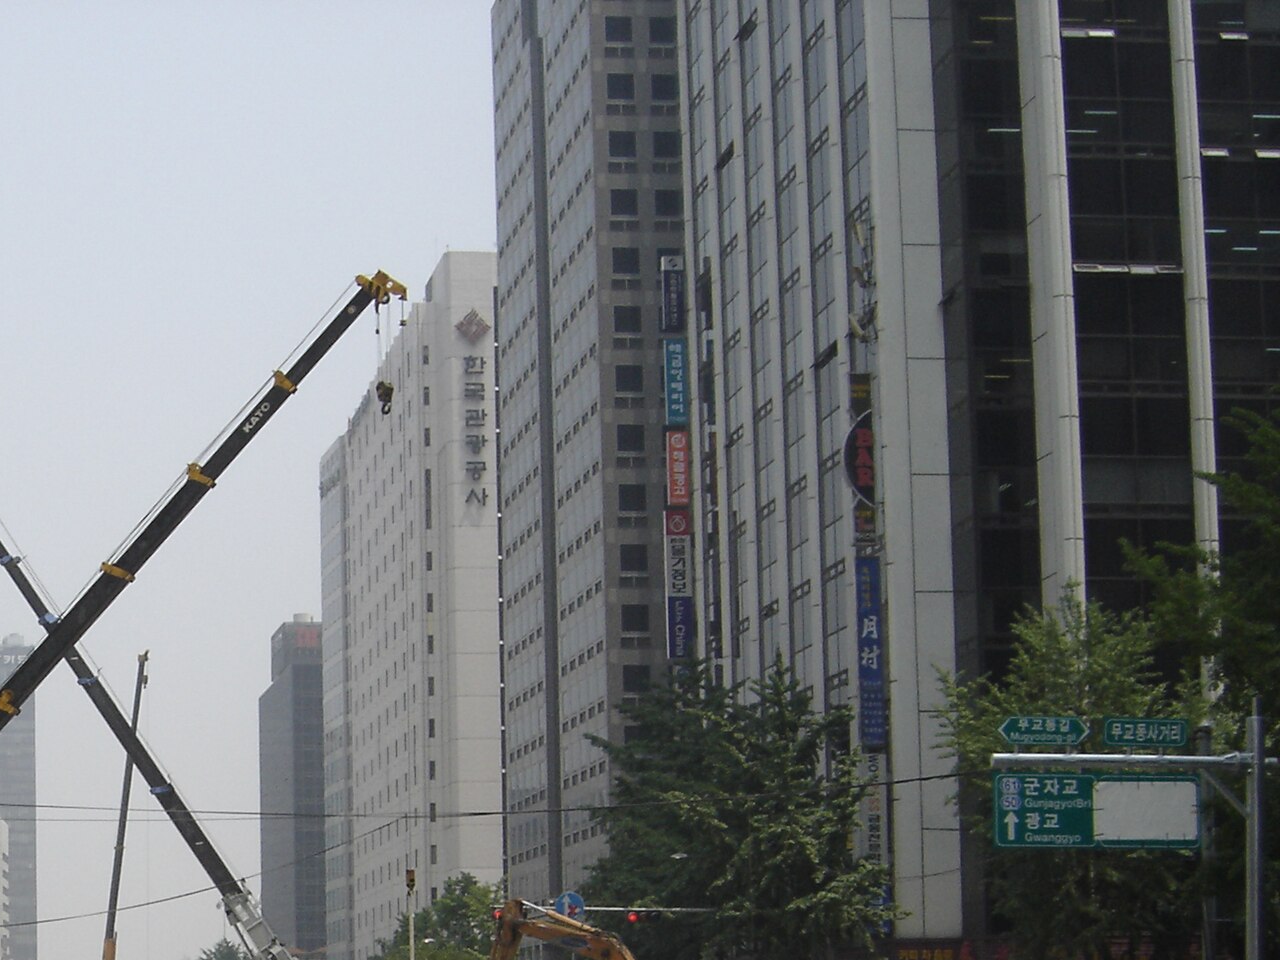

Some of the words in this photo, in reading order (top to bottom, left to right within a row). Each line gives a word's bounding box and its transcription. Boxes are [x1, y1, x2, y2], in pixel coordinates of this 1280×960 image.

[242, 401, 271, 433] KATO
[463, 355, 489, 507] 한국관광공사
[855, 428, 874, 487] BAR
[1017, 718, 1071, 733] 무교동길
[1111, 722, 1182, 742] 무교동사거리
[1024, 777, 1079, 796] 군자교
[1024, 812, 1060, 830] 광교
[1024, 832, 1082, 844] Gwanggyo
